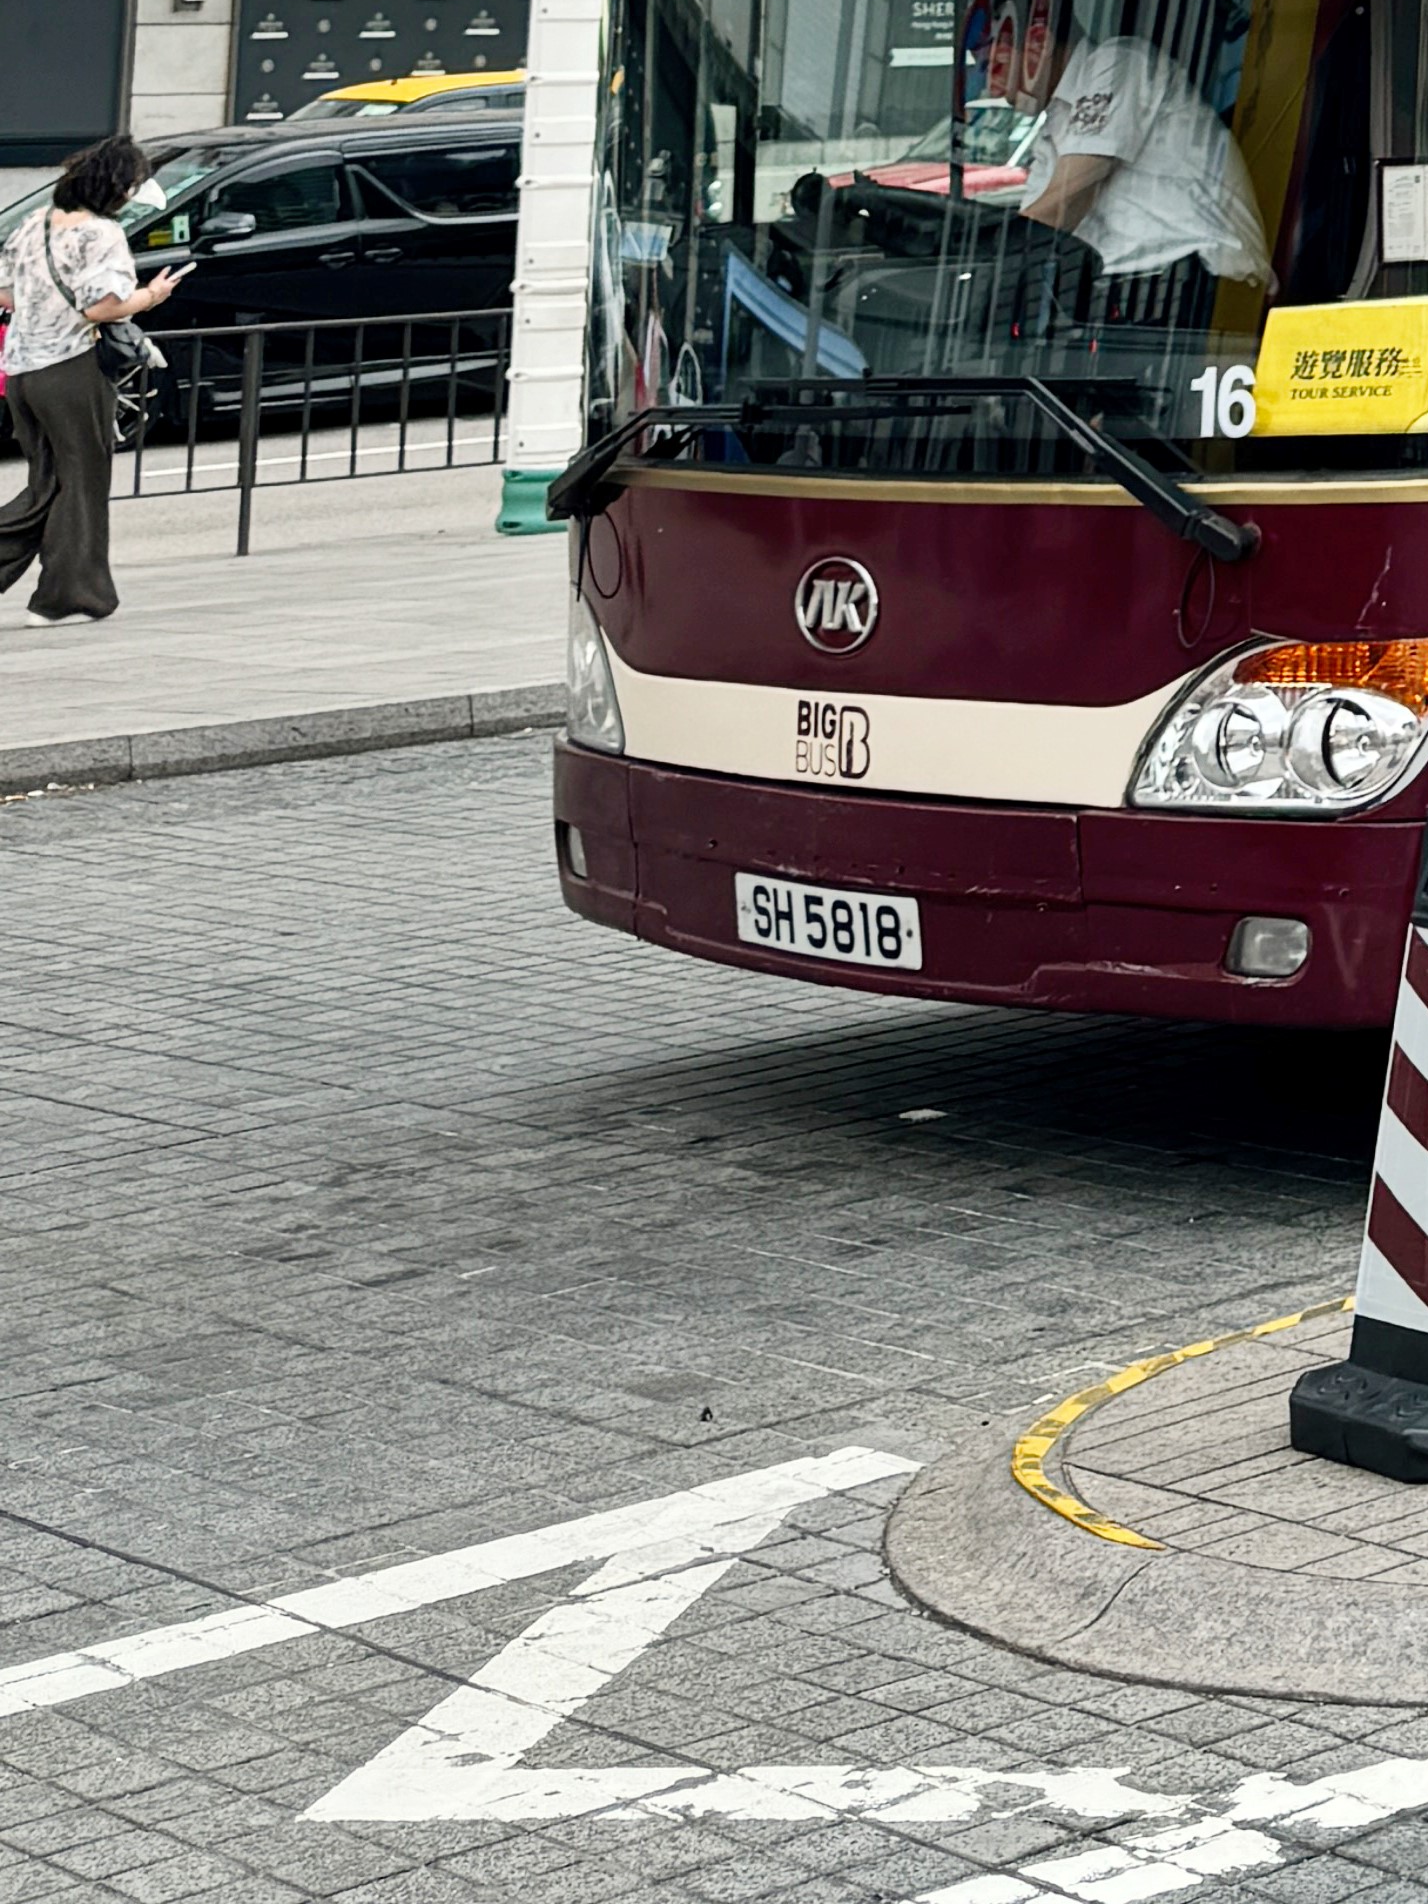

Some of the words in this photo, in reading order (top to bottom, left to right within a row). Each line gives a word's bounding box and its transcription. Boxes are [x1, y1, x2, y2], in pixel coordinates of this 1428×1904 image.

[1290, 347, 1408, 380] 遊覽服務
[1190, 364, 1256, 439] 16
[1290, 387, 1329, 400] TOUR
[1331, 385, 1393, 399] SERVICE
[796, 699, 837, 740] BIG
[795, 739, 837, 778] BUS
[752, 884, 796, 944] SH
[803, 894, 903, 960] 5818
